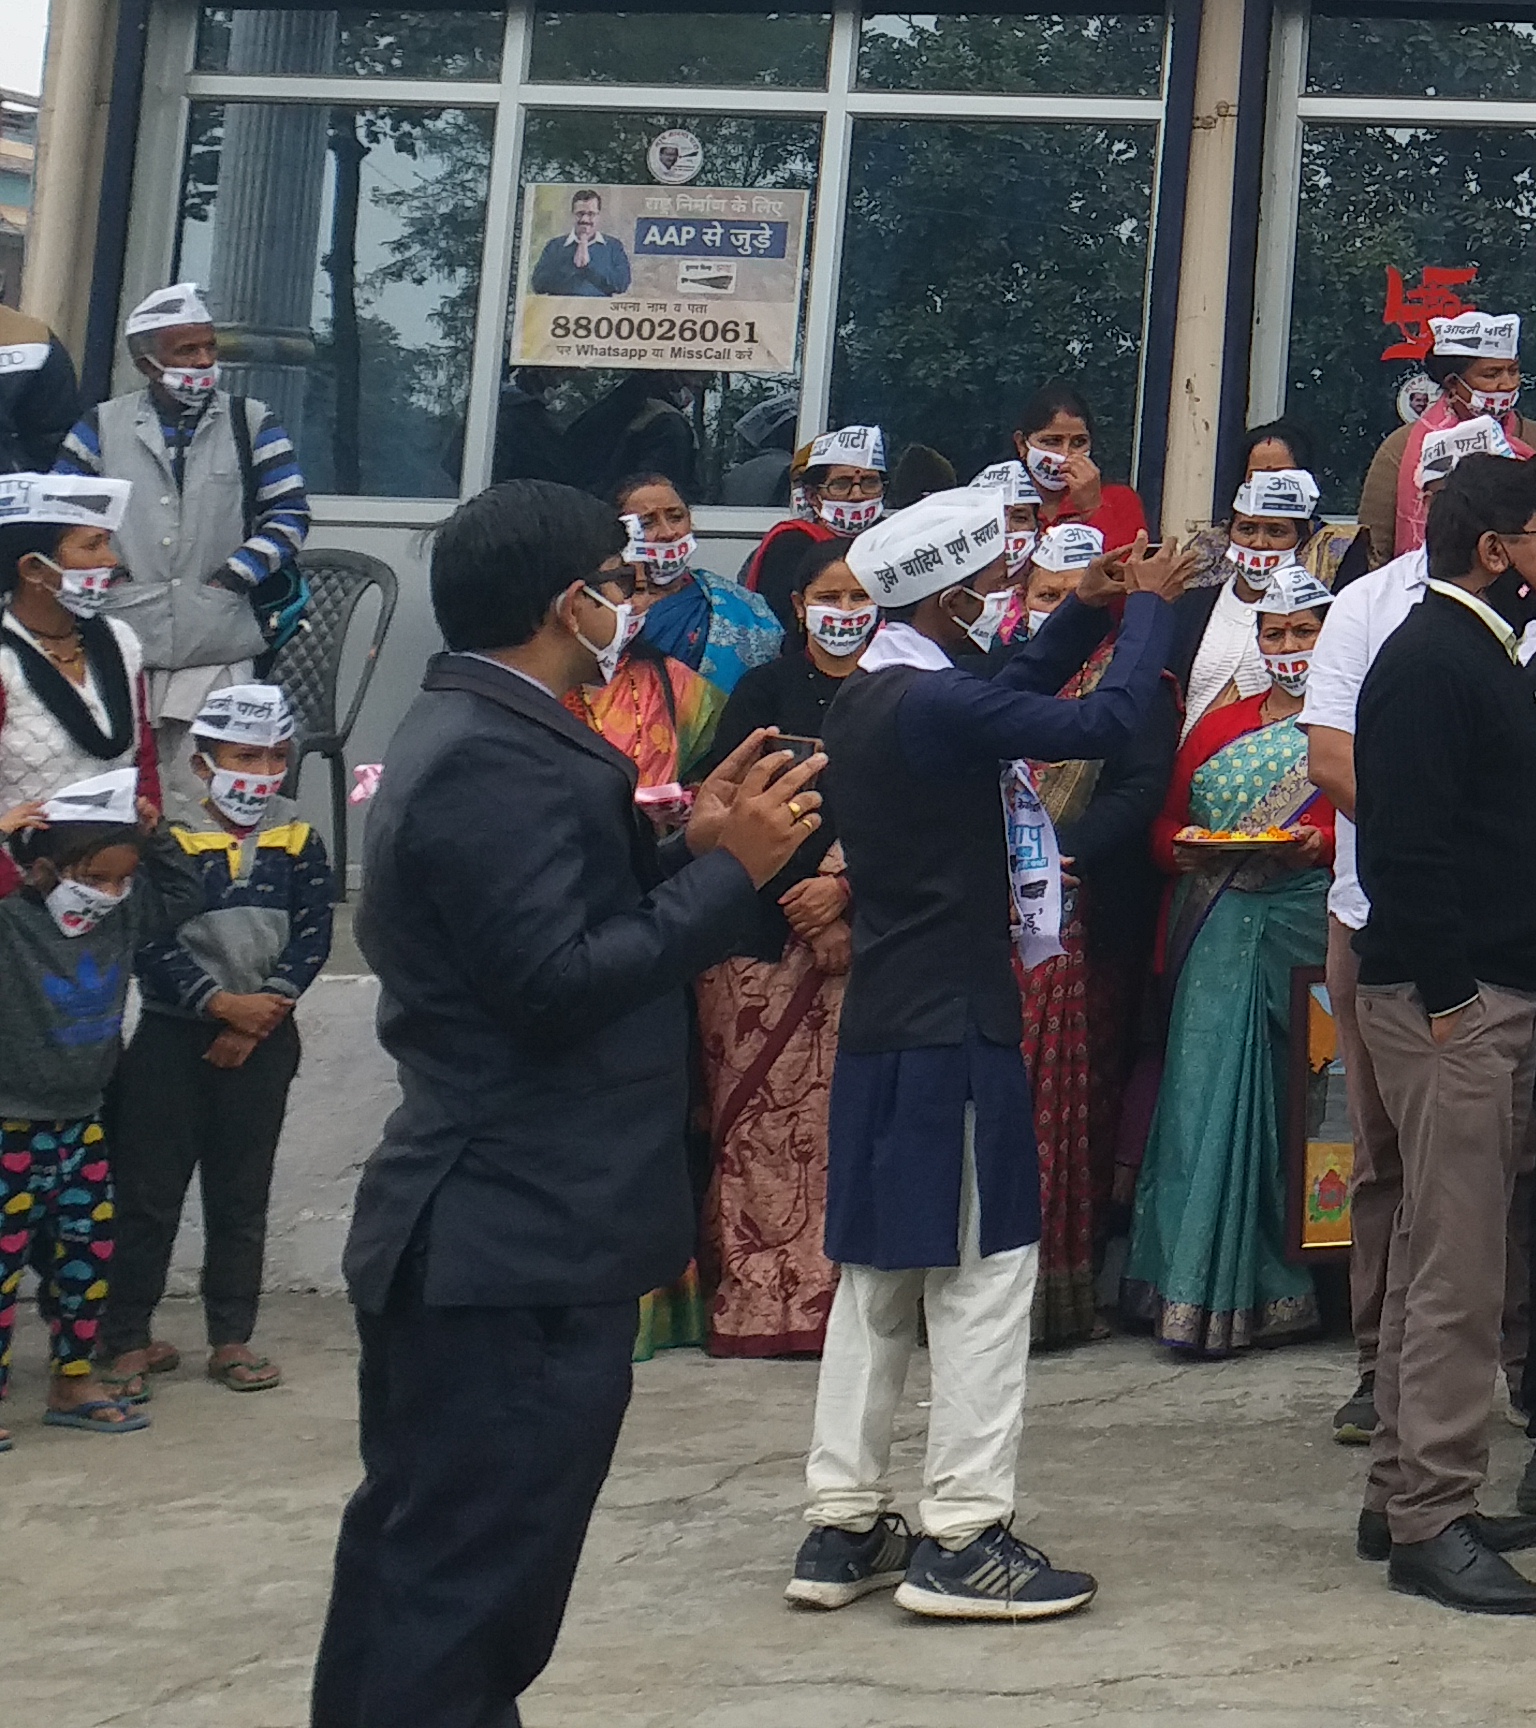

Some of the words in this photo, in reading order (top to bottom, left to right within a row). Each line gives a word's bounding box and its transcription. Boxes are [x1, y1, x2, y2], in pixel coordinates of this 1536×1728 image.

[676, 193, 728, 214] निर्माण
[731, 194, 747, 213] के
[751, 195, 784, 217] लिए
[643, 226, 695, 246] AAP
[702, 222, 722, 247] से
[610, 302, 640, 313] अपना
[647, 302, 667, 314] नाम
[551, 316, 759, 344] 8800026061
[1484, 322, 1514, 339] पार्टी
[576, 345, 647, 360] Whatsapp
[670, 347, 730, 361] MissCall
[1454, 430, 1488, 454] पार्टी
[874, 563, 899, 593] मुझे
[901, 544, 944, 579] चाहिये
[948, 533, 971, 566] पूर्ण
